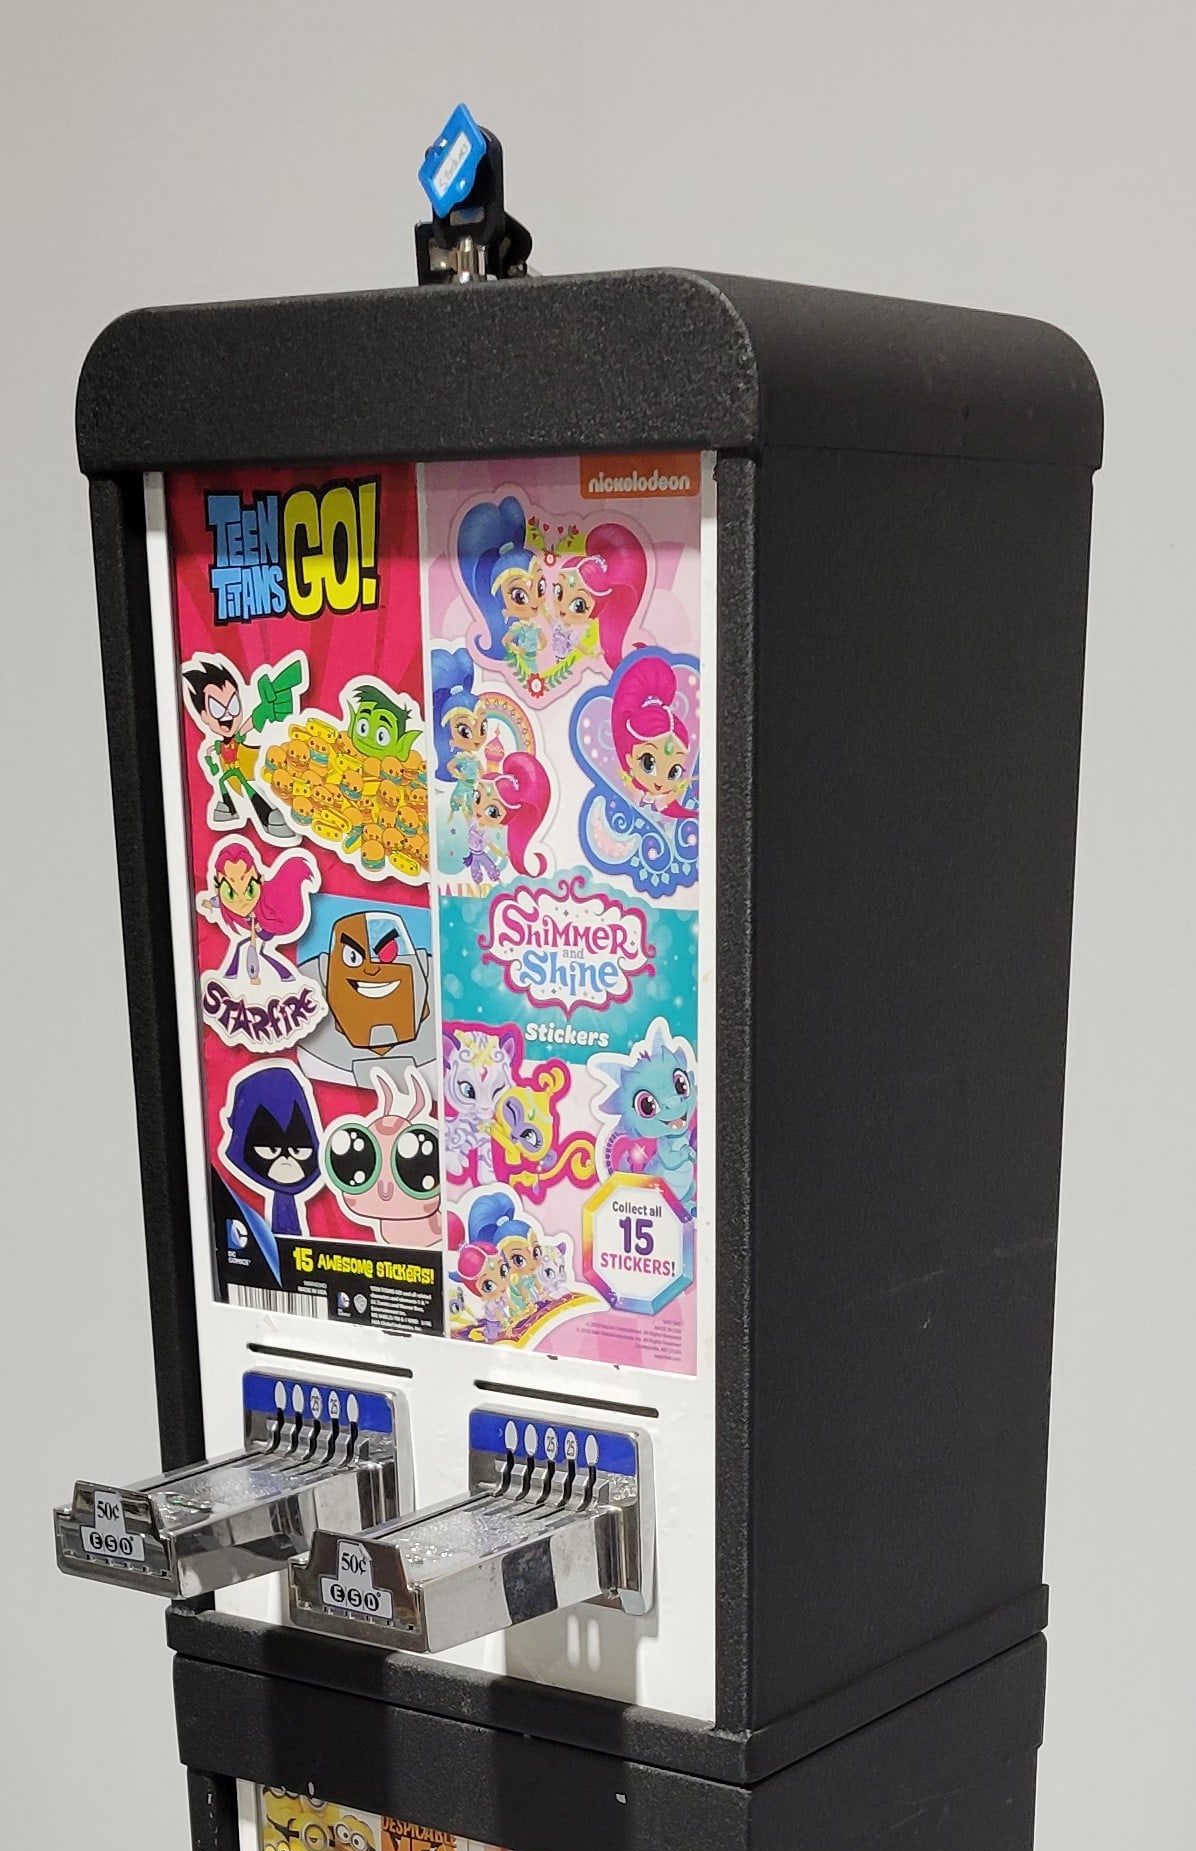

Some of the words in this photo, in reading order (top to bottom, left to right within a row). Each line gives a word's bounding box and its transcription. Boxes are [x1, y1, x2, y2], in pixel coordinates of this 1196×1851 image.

[588, 470, 690, 493] nickelodeon
[207, 494, 279, 568] TEEN
[283, 481, 378, 616] GO!
[211, 564, 287, 620] TITANS
[562, 948, 585, 960] and
[519, 949, 619, 996] Shine
[525, 1022, 610, 1048] Stickers
[612, 1200, 648, 1217] Collect
[650, 1205, 662, 1218] all
[619, 1216, 655, 1255] 15
[292, 1247, 314, 1272] 15
[600, 1252, 676, 1277] STICKERS!
[97, 1501, 120, 1522] 50¢
[341, 1552, 367, 1575] 50¢
